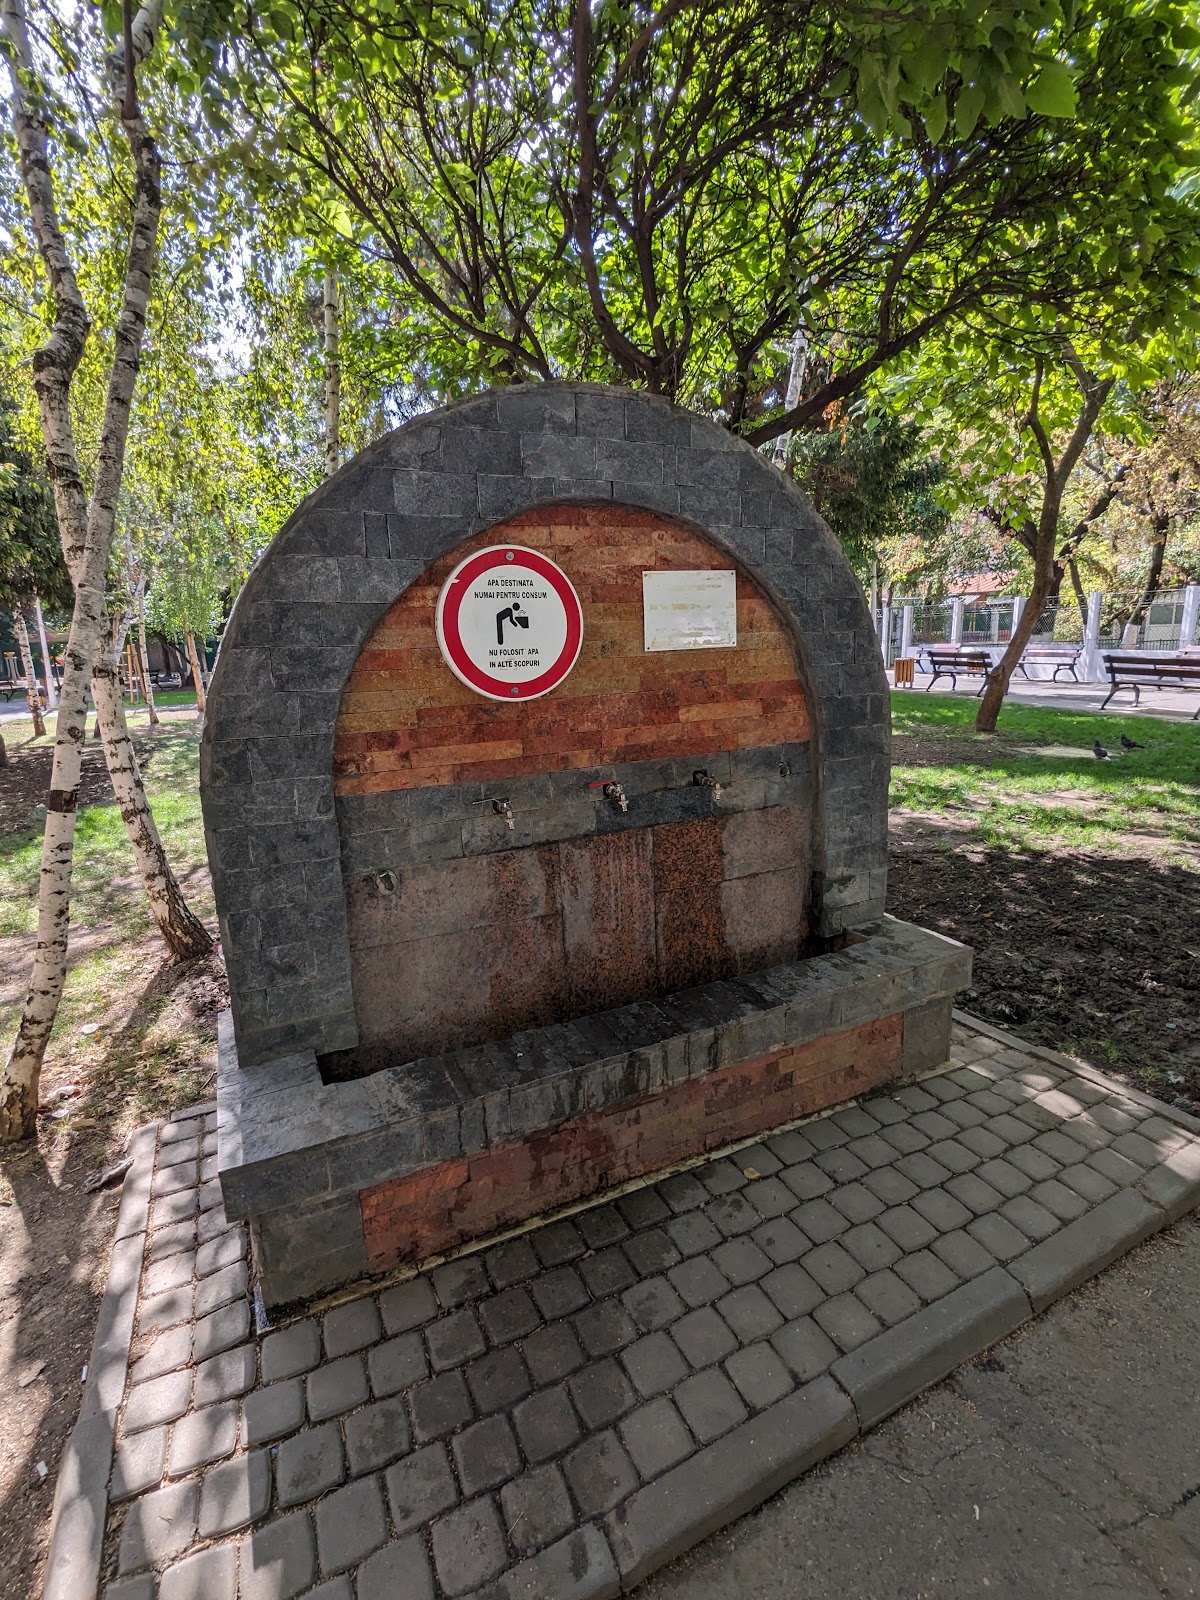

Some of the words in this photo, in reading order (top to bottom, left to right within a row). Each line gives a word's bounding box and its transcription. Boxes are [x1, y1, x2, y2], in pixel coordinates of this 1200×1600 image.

[487, 579, 500, 587] APA
[474, 591, 495, 599] NUMAI
[496, 591, 521, 599] PENTRU
[521, 591, 547, 599] CONSUM
[500, 648, 526, 656] FOLOSIT
[497, 660, 512, 668] ALTE
[513, 659, 540, 667] SCOPURI
